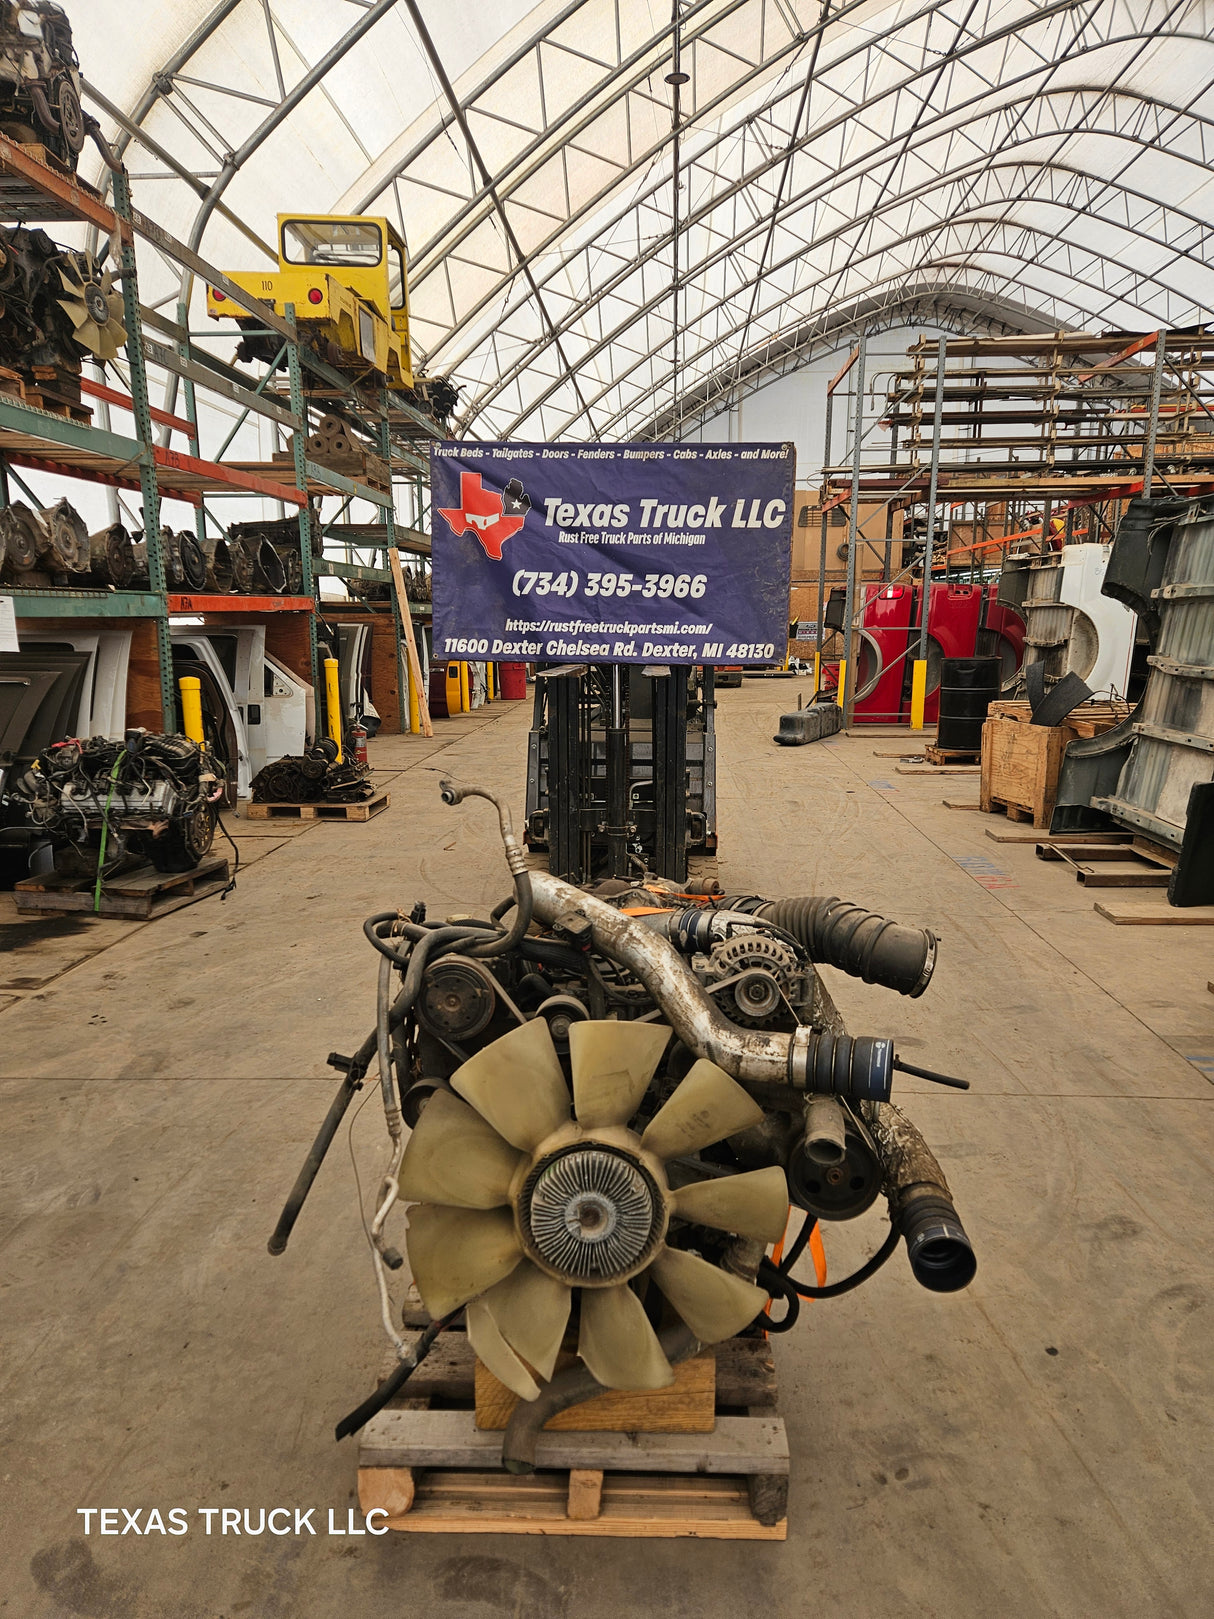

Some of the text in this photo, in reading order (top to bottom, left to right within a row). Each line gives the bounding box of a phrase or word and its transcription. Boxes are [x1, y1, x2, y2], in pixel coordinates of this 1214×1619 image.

[261, 280, 273, 291] 110
[434, 447, 458, 457] Truck
[460, 448, 484, 458] Beds
[492, 448, 534, 460] Tailgates
[542, 449, 569, 459] Doors
[577, 449, 615, 459] Fenders
[623, 450, 664, 461] Bumpers
[673, 449, 697, 459] Cabs
[705, 449, 732, 459] Axles
[740, 449, 759, 460] and
[761, 449, 789, 460] More!
[544, 496, 786, 529] Texas Truck LLC
[559, 531, 705, 546] Rust Free Truck Parts of Michigan
[512, 569, 708, 598] (734) 395-3966
[505, 618, 713, 637] https://rustfreetruckpartsmi.com/
[444, 638, 775, 660] 11600 Dexter Chelsea Rd. Dexter, MI 48130
